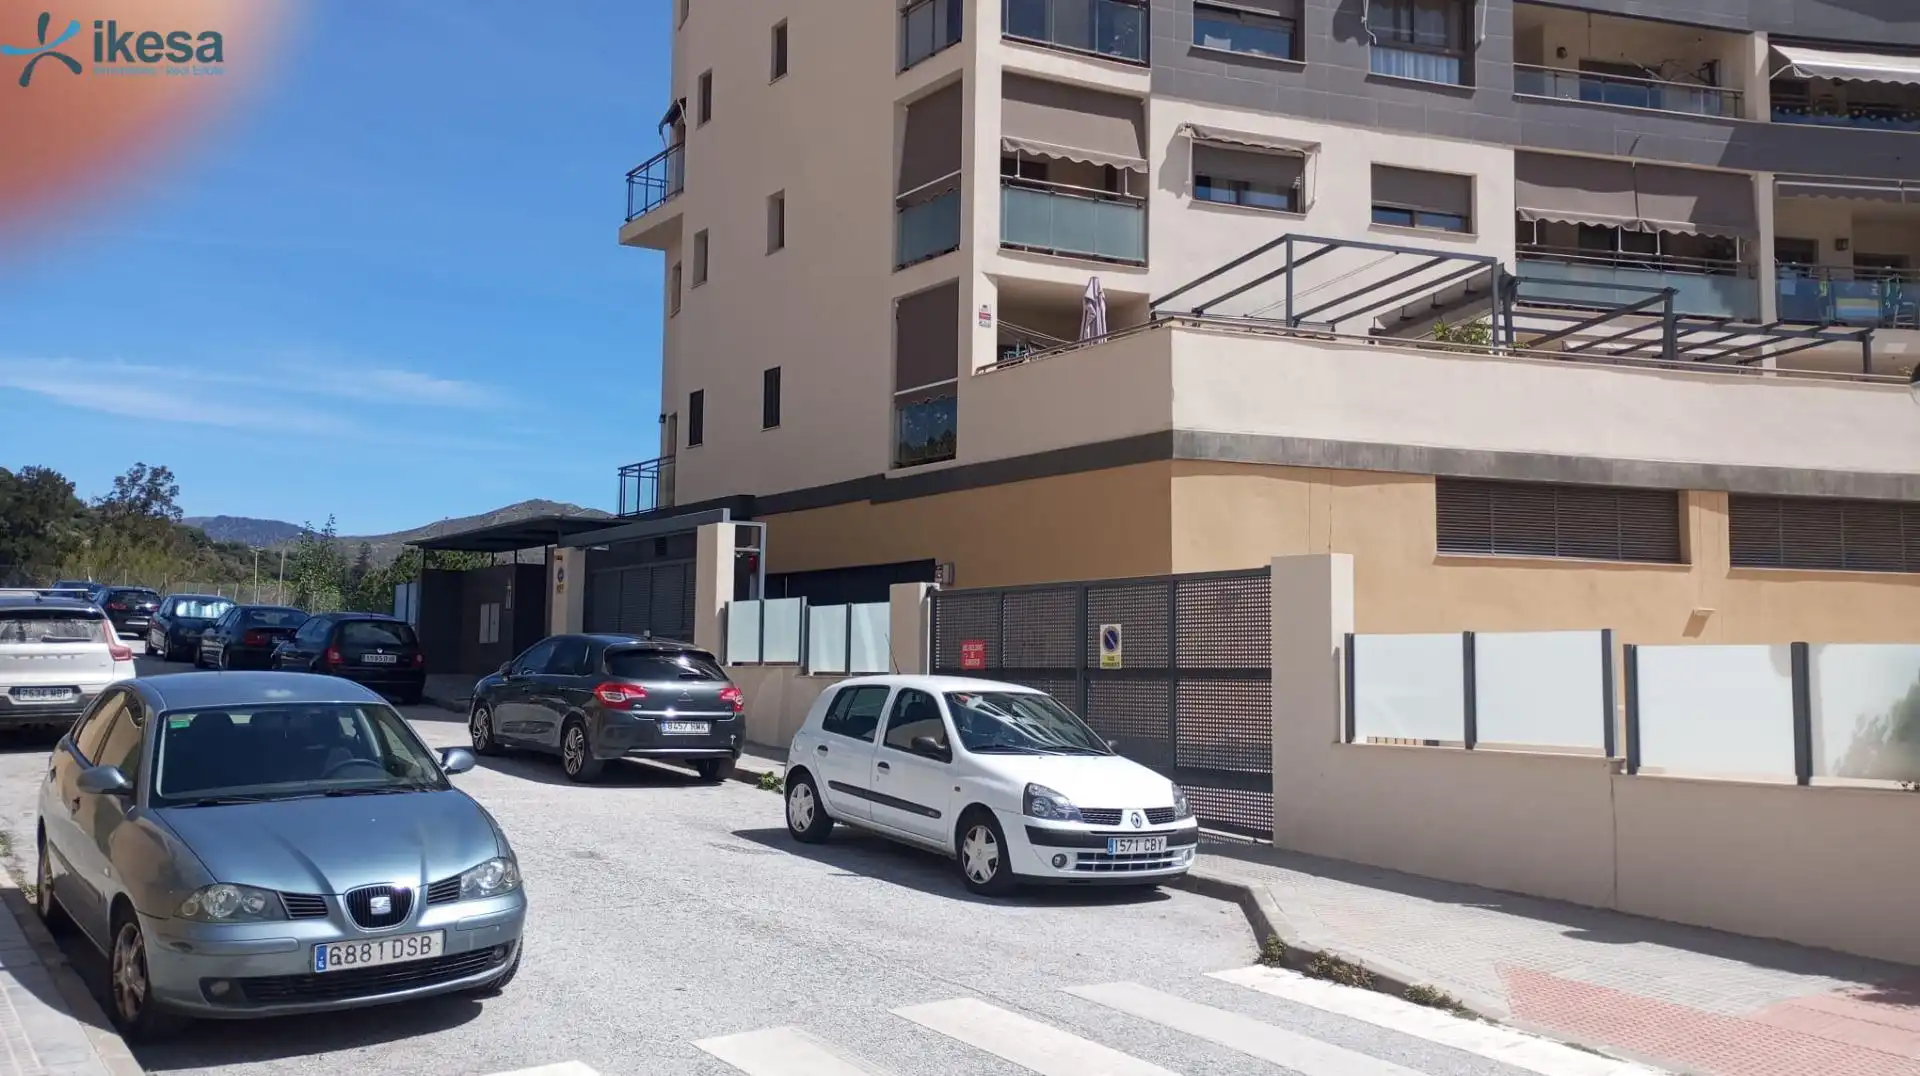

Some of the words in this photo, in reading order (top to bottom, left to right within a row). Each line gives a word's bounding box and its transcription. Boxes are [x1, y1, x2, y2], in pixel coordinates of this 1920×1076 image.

[1115, 839, 1139, 853] 1571
[1144, 838, 1164, 851] CBY
[329, 940, 384, 967] 6881
[392, 935, 432, 960] DSB
